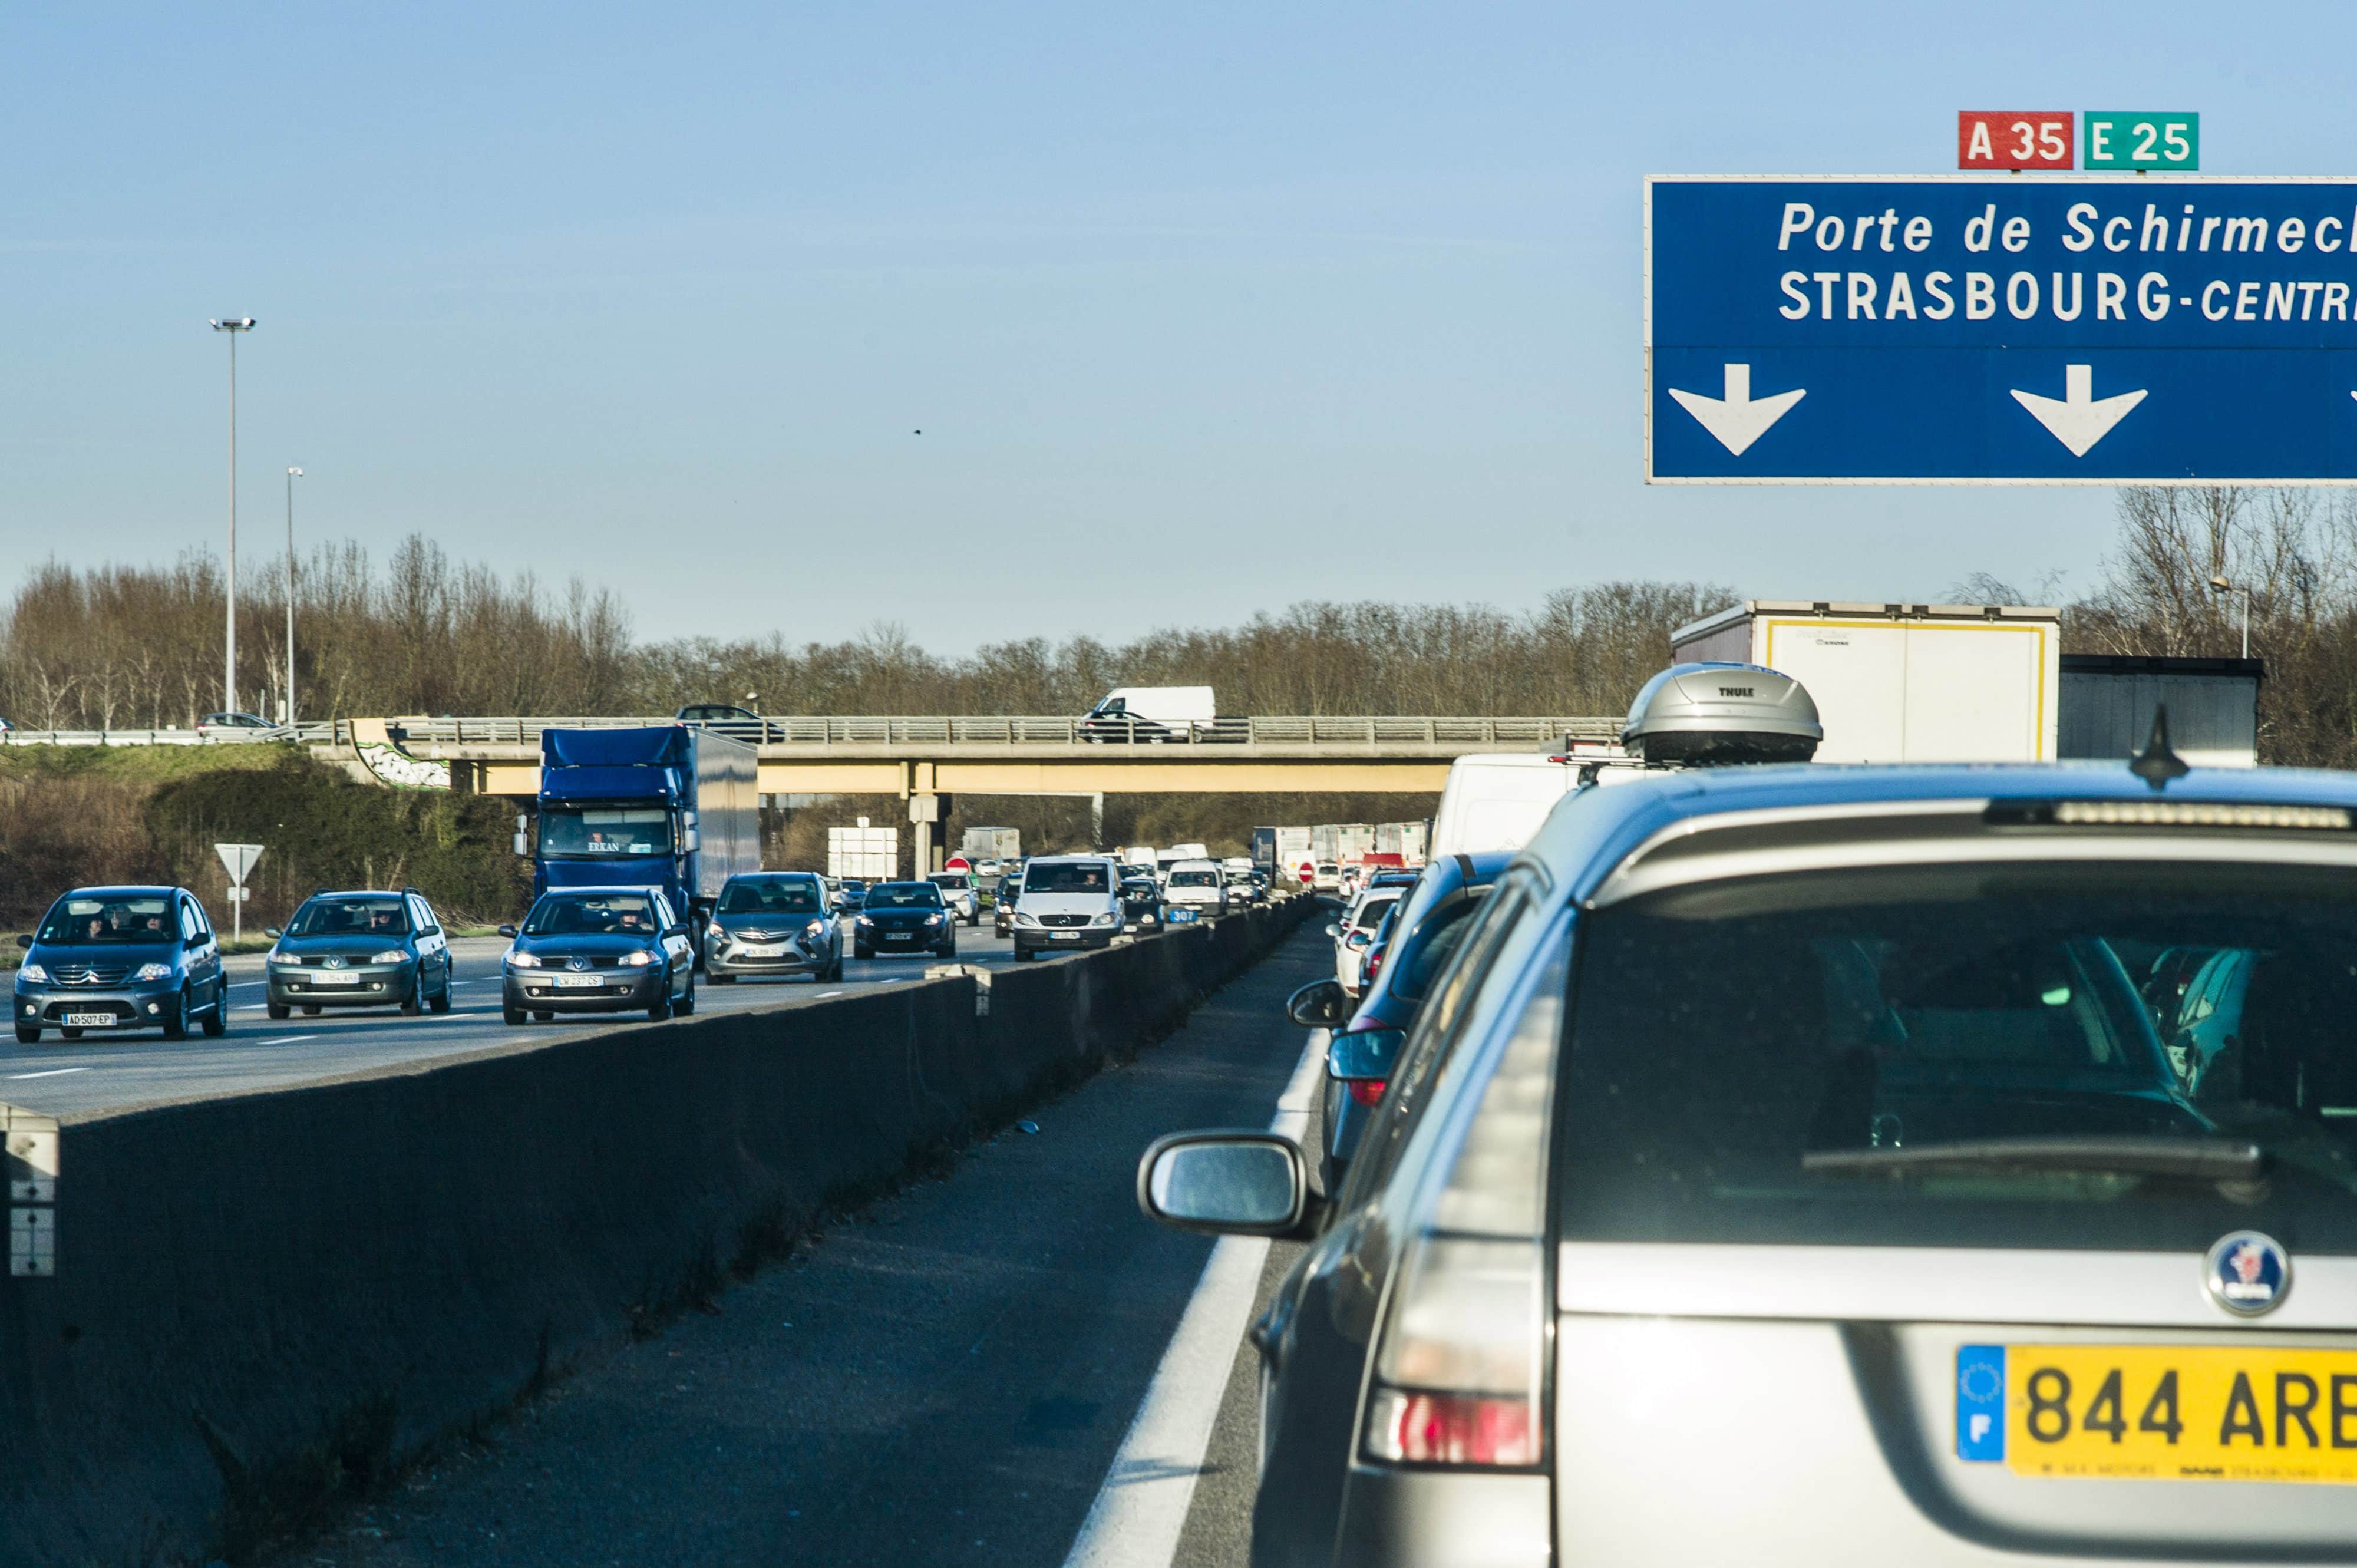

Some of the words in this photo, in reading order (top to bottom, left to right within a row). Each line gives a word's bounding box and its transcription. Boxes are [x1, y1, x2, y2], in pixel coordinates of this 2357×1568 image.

[1968, 121, 1993, 160] A
[2010, 121, 2065, 161] 35
[2092, 122, 2114, 160] E
[2132, 122, 2190, 161] 25
[1778, 203, 1932, 252] Porte
[1964, 204, 2031, 252] de
[1779, 271, 2357, 321] STRASBOURG-CENTR
[1718, 687, 1754, 697] THULE
[588, 842, 619, 851] ERKAN
[1173, 911, 1194, 921] 307
[2027, 1368, 2183, 1444] 844
